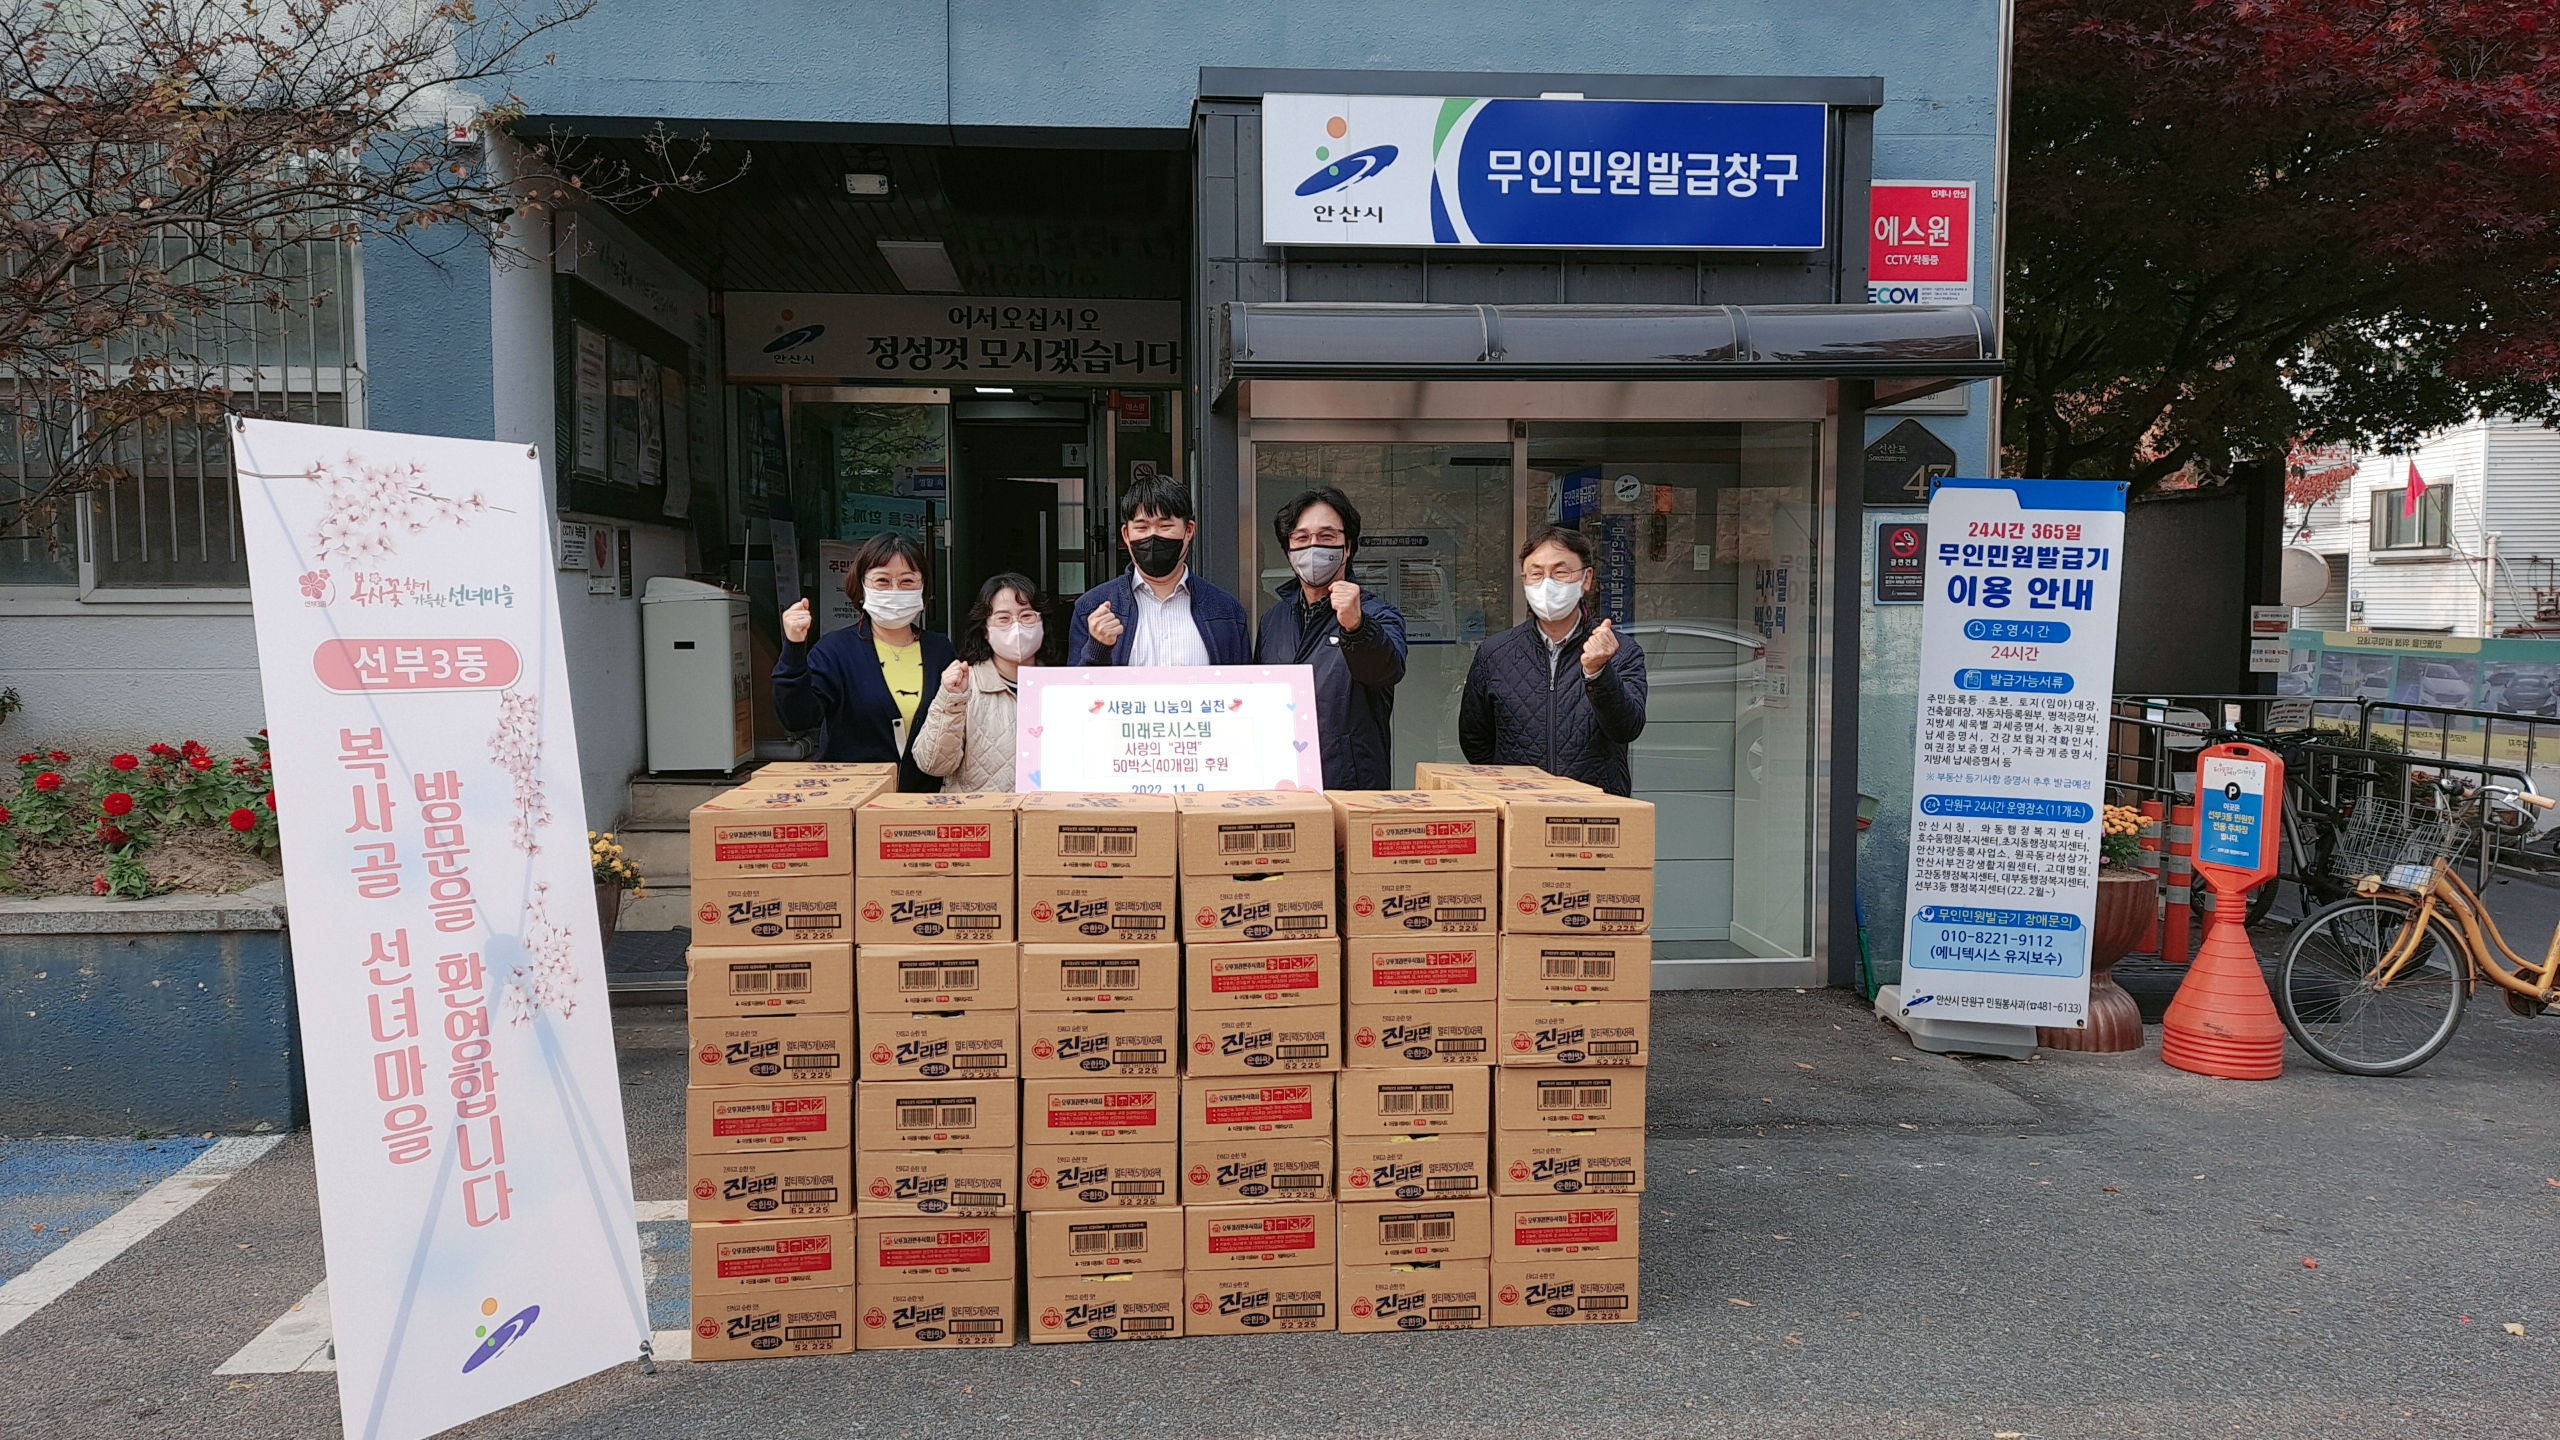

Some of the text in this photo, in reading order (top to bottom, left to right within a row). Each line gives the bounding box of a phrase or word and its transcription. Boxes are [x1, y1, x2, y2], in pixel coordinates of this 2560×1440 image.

[1487, 149, 1799, 198] 무인민원발급창구
[1314, 205, 1383, 224] 안산시
[1874, 216, 1950, 247] 에스원
[1885, 254, 1939, 266] CCTV 작동중
[1867, 287, 1918, 304] ECOM
[948, 305, 1101, 332] 어서오십시오
[773, 353, 815, 365] 안산시
[866, 335, 1182, 375] 정성껏 모시겠습니다
[1968, 522, 2082, 541] 24시간 365일
[829, 560, 853, 573] 주민
[1938, 543, 2109, 571] 무인민원발급기
[350, 572, 430, 608] 복사꽃 향기
[449, 584, 514, 608] 선녀마을
[1947, 574, 2094, 611] 이용 안내
[1990, 623, 2050, 639] 운영시간
[353, 646, 488, 684] 선부3동
[1990, 645, 2040, 662] 24시간
[1990, 673, 2065, 689] 발급가능서류
[1107, 699, 1225, 715] 사랑과 나눔의 실천
[1122, 721, 1212, 739] 미래로시스템
[1925, 718, 1955, 729] 지방세
[1125, 742, 1161, 756] 사랑의
[1204, 757, 1228, 772] 후원
[1923, 754, 1950, 765] 지방세
[2002, 757, 2012, 768] 등
[1944, 799, 2086, 819] 단원구 24시간 운영장소(11개소)
[1914, 881, 1947, 892] 선부3동
[727, 901, 782, 924] 진라면
[890, 900, 944, 924] 진라면
[1056, 900, 1108, 923] 진라면
[1220, 903, 1271, 927] 진라면
[1382, 895, 1431, 919] 진라면
[1541, 892, 1591, 915] 진라면
[753, 925, 781, 935] 순한맛
[915, 924, 942, 934] 순한맛
[1081, 923, 1107, 934] 순한맛
[1938, 908, 2073, 929] 무인민원발급기 장애문의
[338, 727, 433, 1165] 복사골 선녀마을
[1941, 930, 2053, 948] 010-8221-9112
[2004, 950, 2063, 967] 유지보수)
[413, 769, 513, 1228] 방문을 환영합니다
[1936, 994, 1959, 1007] 안산시
[1961, 996, 1985, 1008] 단원구
[1057, 1036, 1110, 1060] 진라면
[1222, 1032, 1273, 1055] 진라면
[1382, 1026, 1432, 1048] 진라면
[1535, 1028, 1584, 1051] 진라면
[725, 1040, 780, 1064] 진라면
[896, 1040, 949, 1064] 진라면
[1559, 1051, 1584, 1061] 순한맛
[752, 1064, 779, 1074] 순한맛
[1056, 1167, 1109, 1190] 진라면
[1217, 1162, 1268, 1186] 진라면
[1373, 1164, 1424, 1188] 진라면
[1532, 1158, 1582, 1181] 진라면
[723, 1176, 778, 1200] 진라면
[895, 1176, 949, 1200] 진라면
[1241, 1185, 1267, 1195] 순한맛
[1219, 1291, 1270, 1315] 진라면
[1375, 1294, 1426, 1318] 진라면
[1525, 1283, 1574, 1306] 진라면
[892, 1305, 946, 1329] 진라면
[1064, 1304, 1117, 1328] 진라면
[1548, 1306, 1573, 1316] 순한맛
[727, 1312, 782, 1340] 진라면
[917, 1330, 944, 1340] 순한맛
